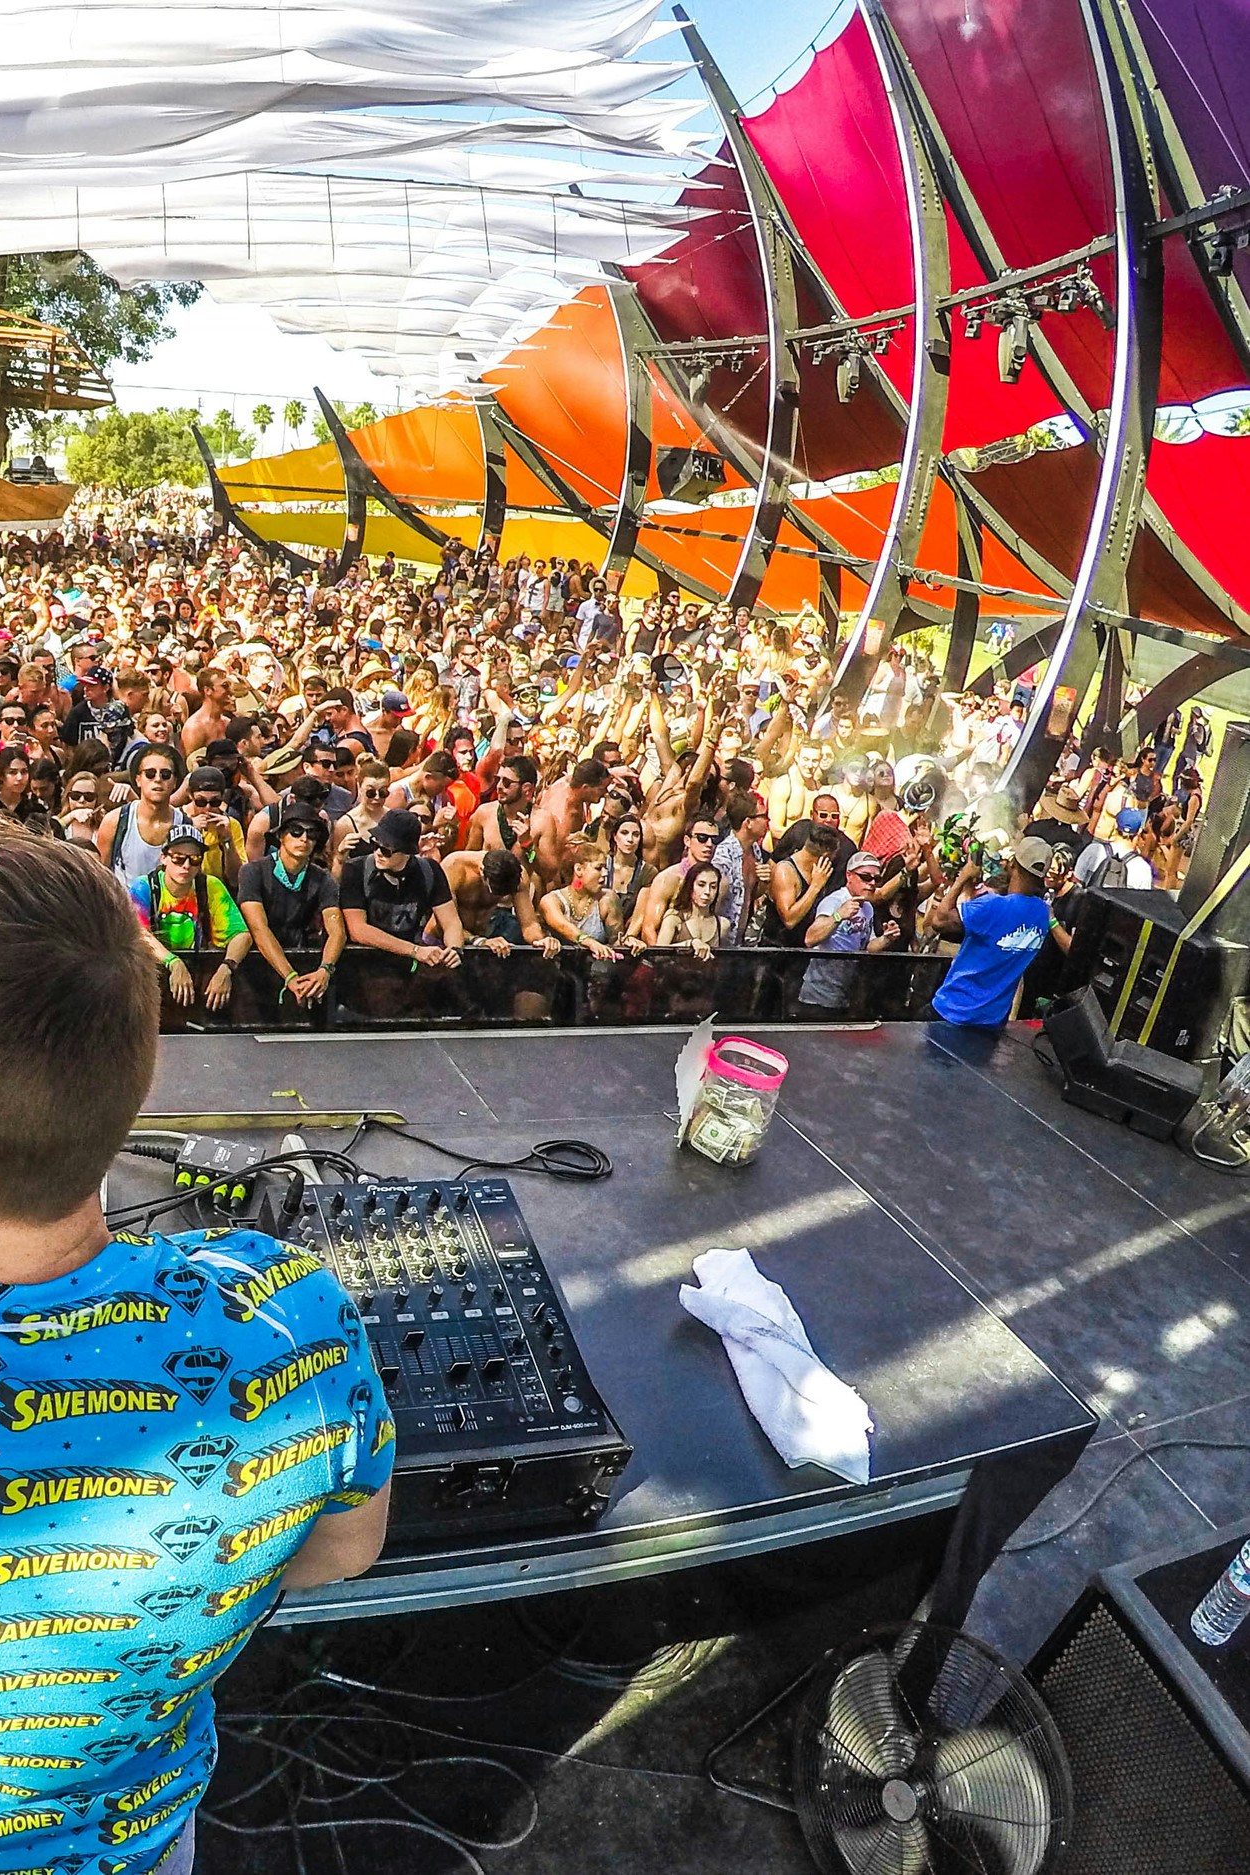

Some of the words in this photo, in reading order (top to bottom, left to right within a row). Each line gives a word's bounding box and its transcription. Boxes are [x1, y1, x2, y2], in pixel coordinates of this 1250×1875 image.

[367, 1185, 418, 1193] Pioneer
[19, 1302, 170, 1345] SAVEMONEY
[245, 1346, 349, 1422] SAVEMONEY
[10, 1389, 180, 1432] SAVEMONEY
[234, 1425, 355, 1496] SAVEMONEY
[1, 1476, 177, 1515] SAVEMONEY
